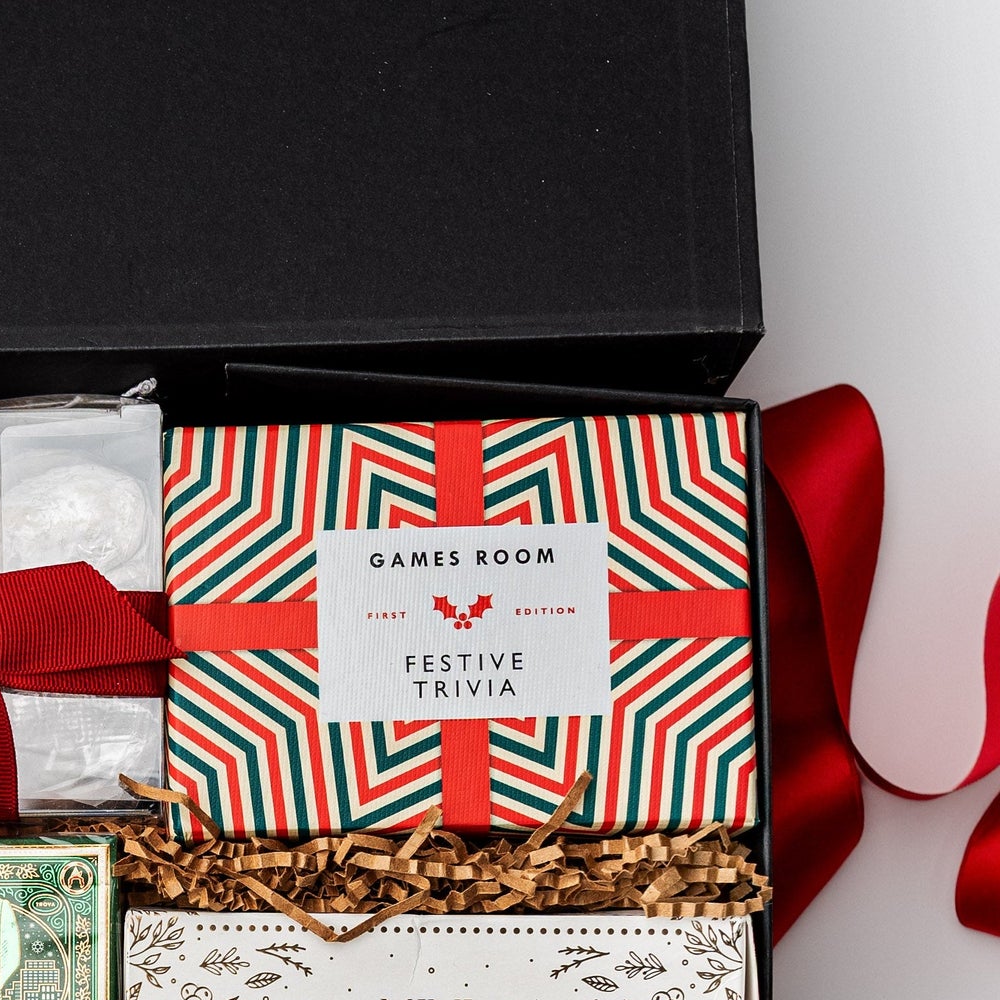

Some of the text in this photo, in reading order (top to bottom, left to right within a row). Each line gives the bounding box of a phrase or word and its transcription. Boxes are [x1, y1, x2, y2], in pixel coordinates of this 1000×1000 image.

[369, 548, 555, 568] GAMES ROOM
[367, 607, 576, 620] FIRST EDITION
[405, 652, 524, 673] FESTIVE
[413, 679, 516, 698] TRIVIA
